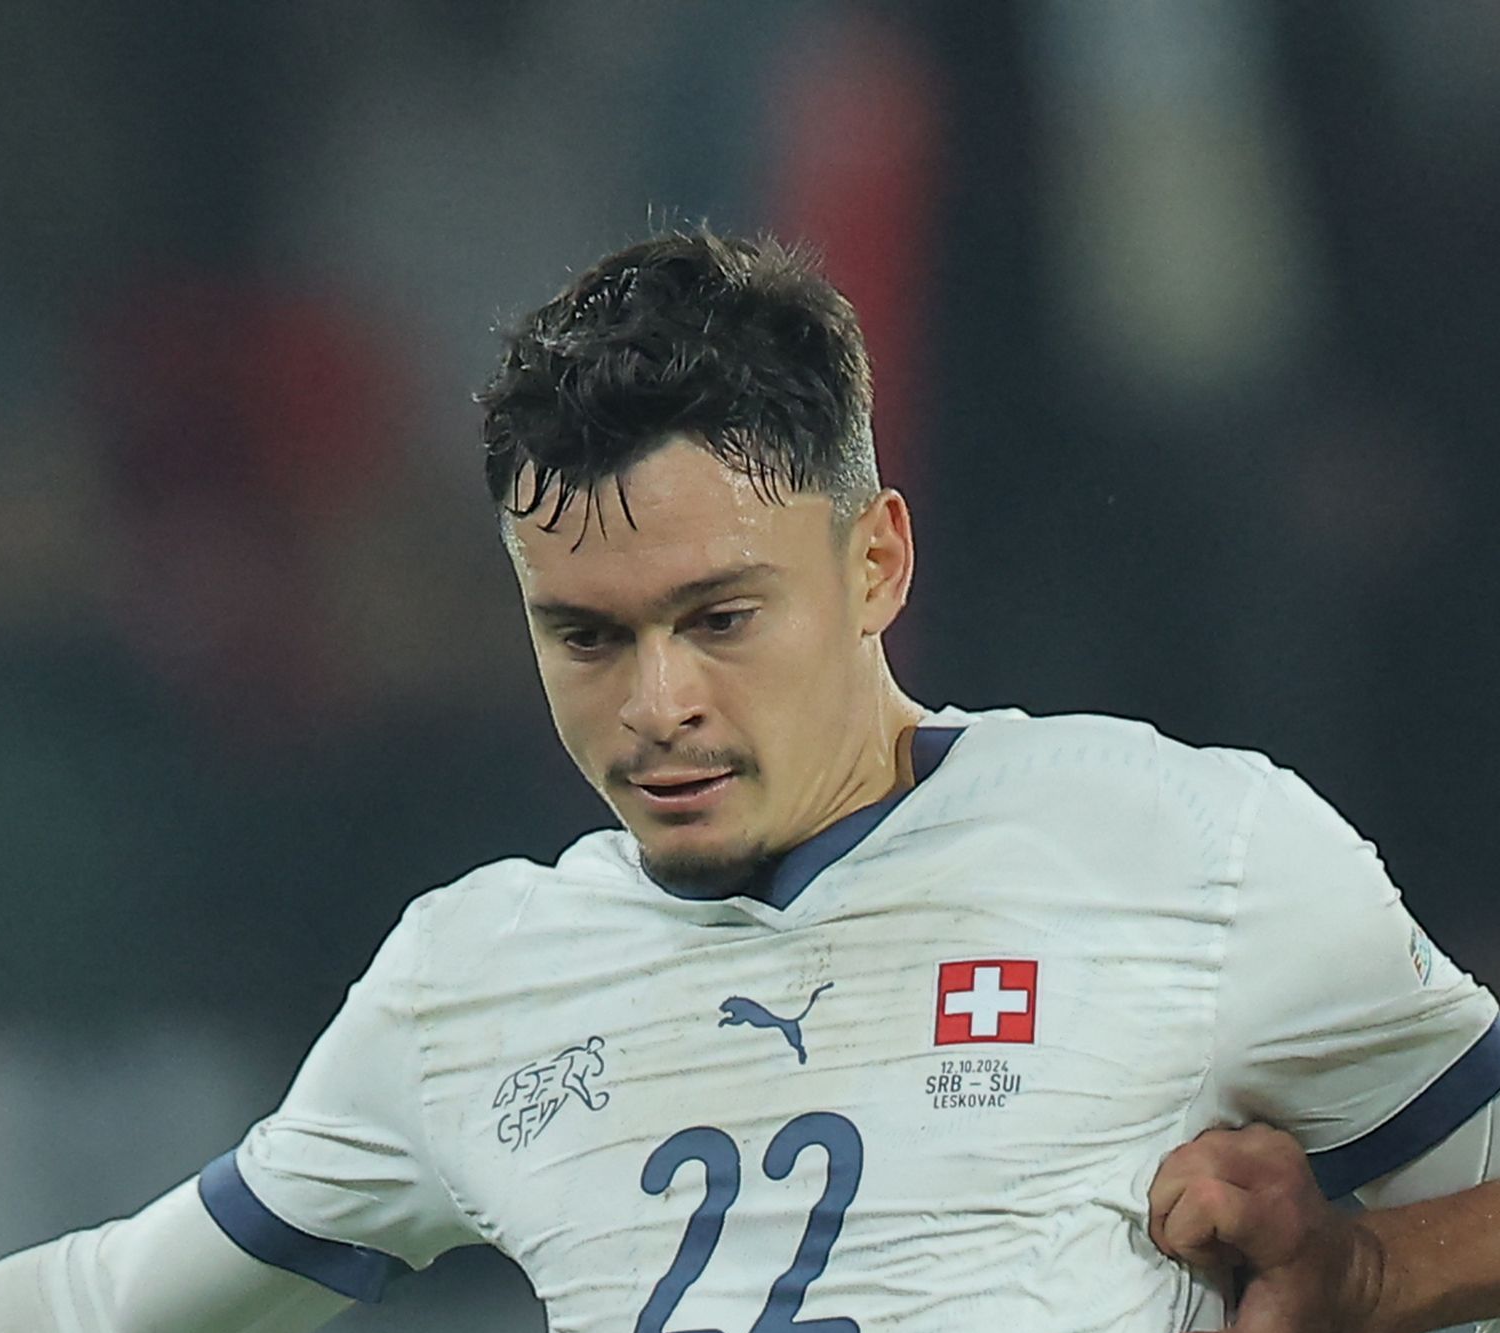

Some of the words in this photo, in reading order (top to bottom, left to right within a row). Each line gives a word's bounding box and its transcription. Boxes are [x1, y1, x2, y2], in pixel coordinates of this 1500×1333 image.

[940, 1059, 1009, 1075] 12.10.2024
[925, 1074, 963, 1095] SRB
[989, 1073, 1022, 1093] SUI
[933, 1093, 1007, 1110] LESKOVAC
